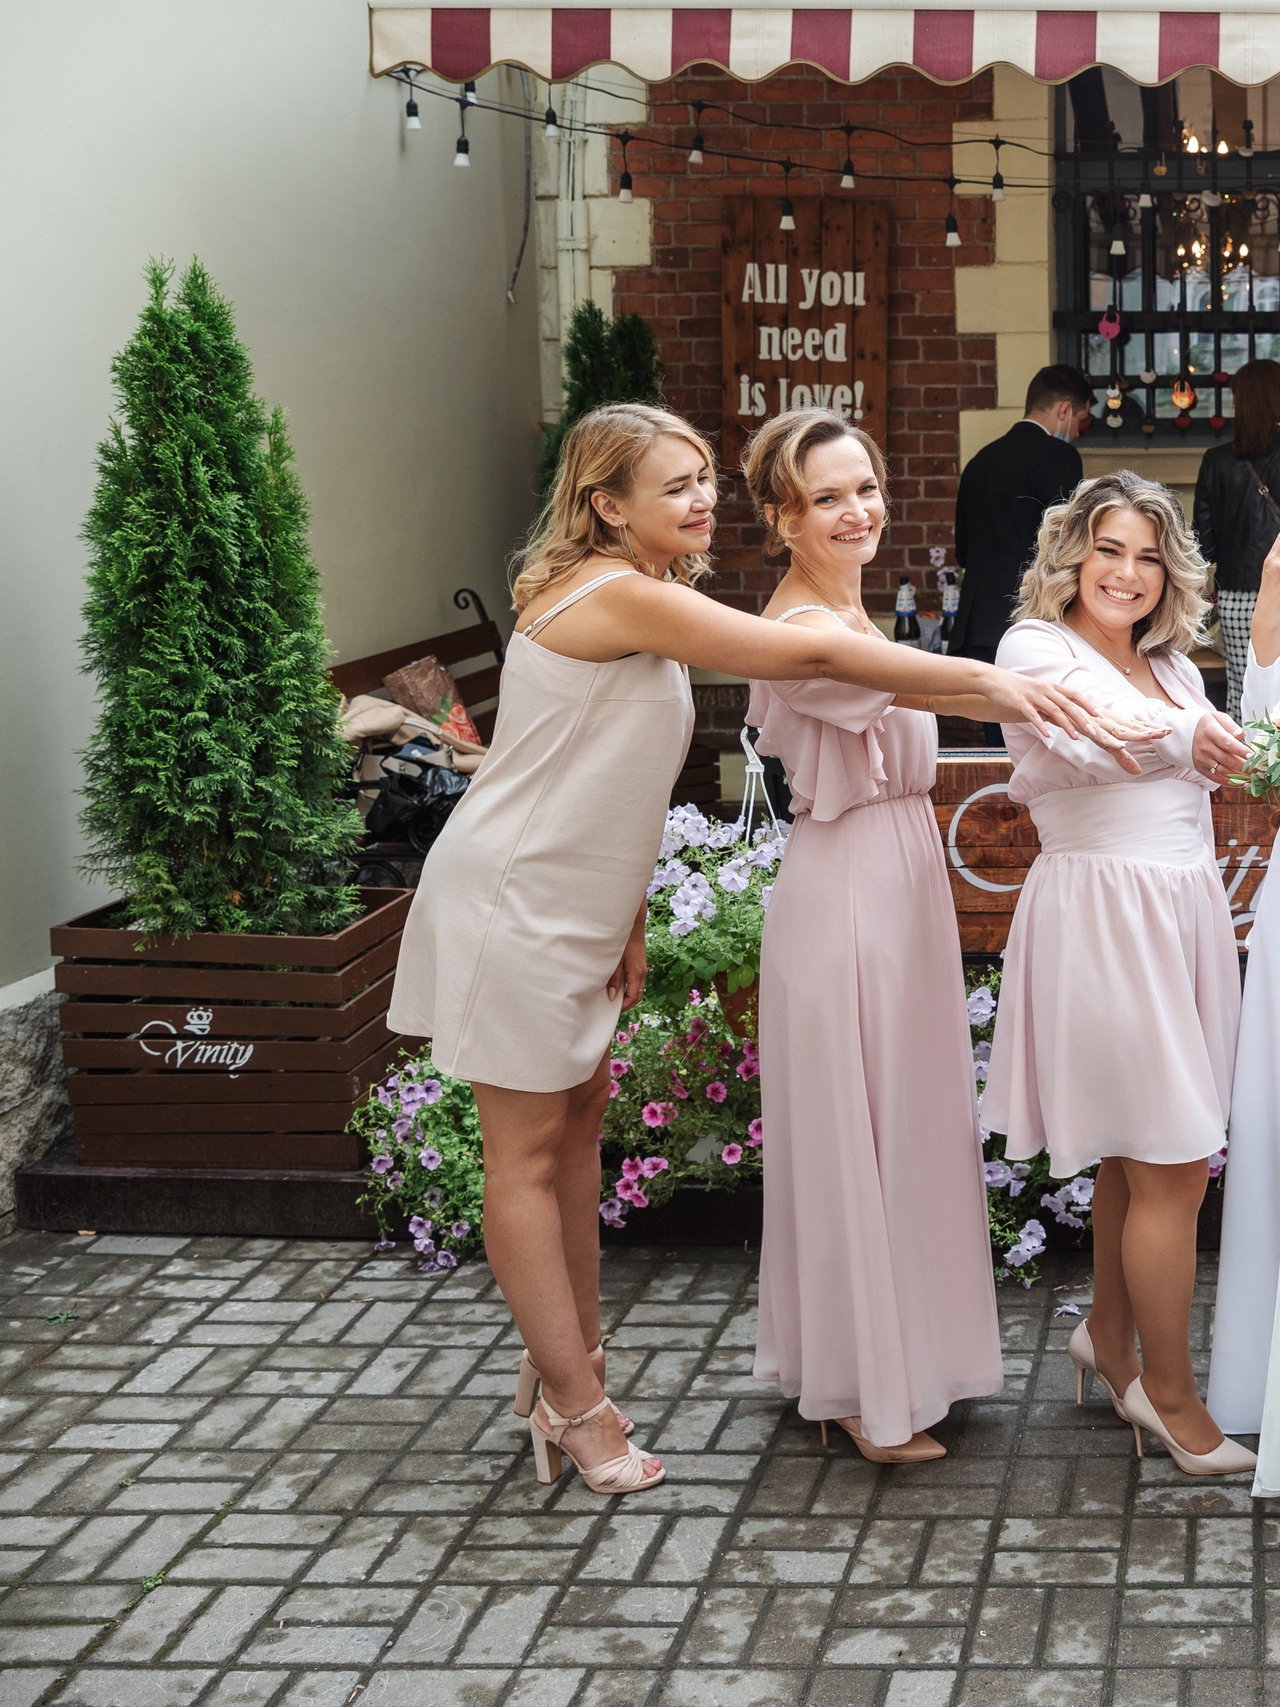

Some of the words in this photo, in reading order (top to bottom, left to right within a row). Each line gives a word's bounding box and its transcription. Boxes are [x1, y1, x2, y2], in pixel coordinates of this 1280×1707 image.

[741, 262, 788, 305] All
[798, 268, 867, 311] you
[758, 322, 848, 363] need
[737, 373, 767, 417] is
[778, 377, 865, 420] love!
